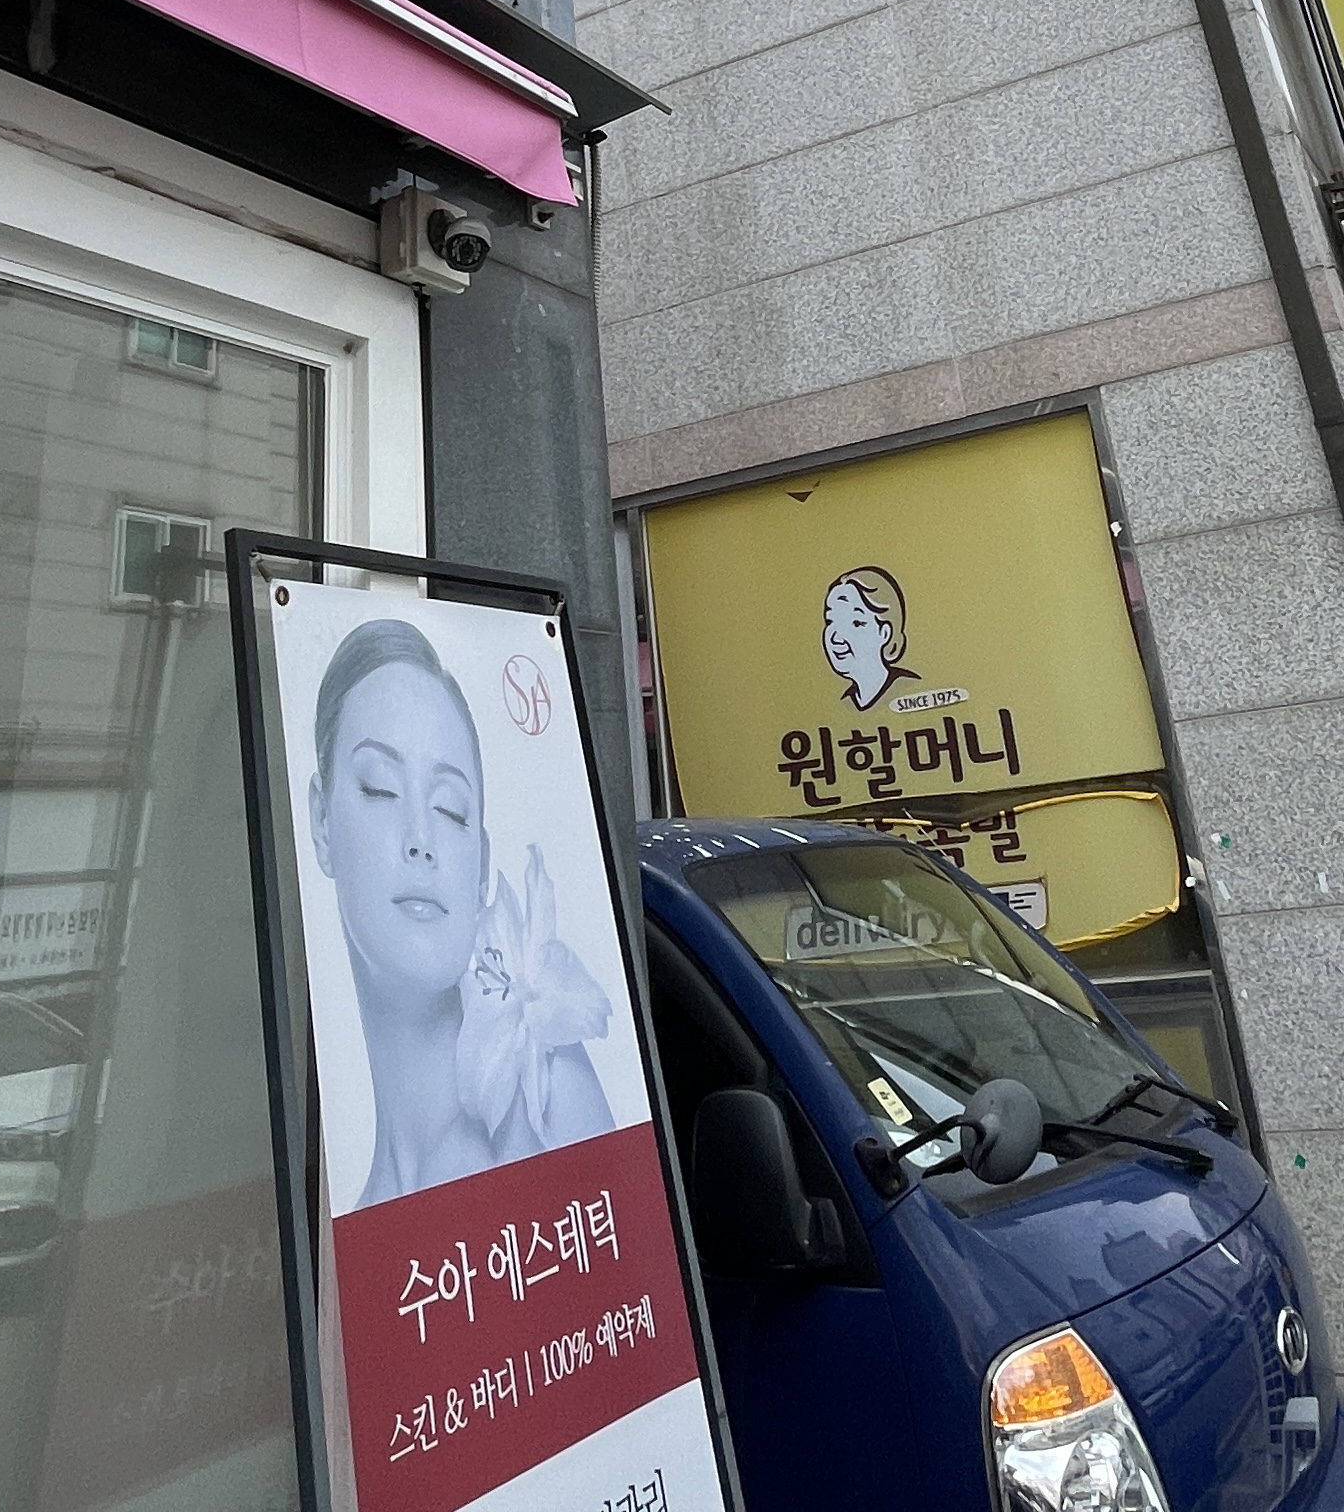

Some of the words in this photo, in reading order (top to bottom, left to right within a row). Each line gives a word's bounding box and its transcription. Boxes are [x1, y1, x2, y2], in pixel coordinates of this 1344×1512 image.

[897, 694, 929, 712] SINCE
[931, 689, 961, 706] 1975
[777, 707, 1022, 808] 원할머니
[796, 910, 947, 951] delivry
[397, 1240, 478, 1344] 수아
[487, 1190, 620, 1302] 에스테틱
[388, 1395, 440, 1463] 스킨
[443, 1387, 469, 1435] &
[470, 1357, 520, 1420] 바디
[541, 1329, 595, 1388] 100%
[596, 1294, 656, 1358] 예약제
